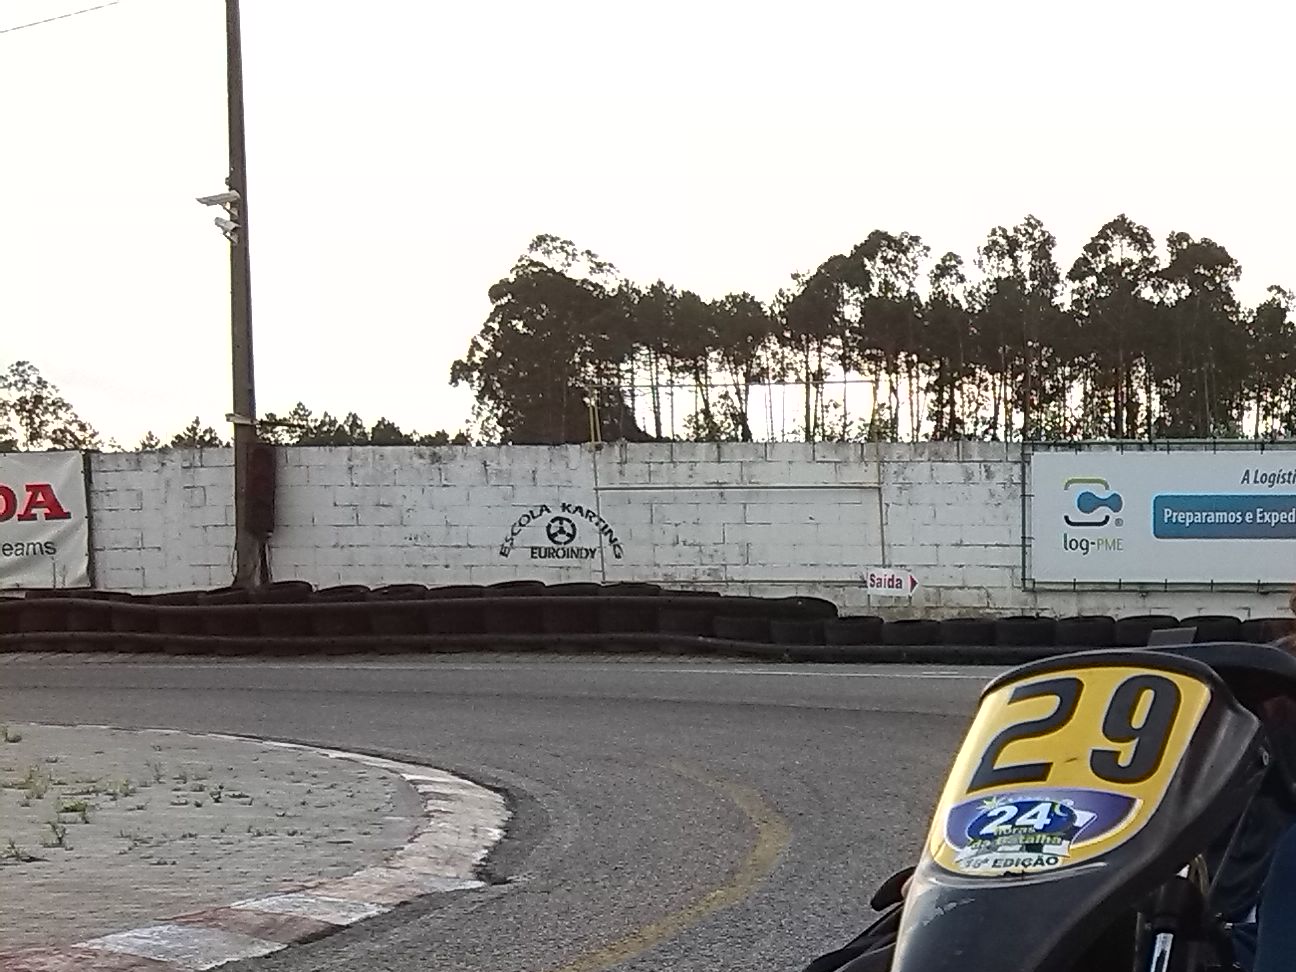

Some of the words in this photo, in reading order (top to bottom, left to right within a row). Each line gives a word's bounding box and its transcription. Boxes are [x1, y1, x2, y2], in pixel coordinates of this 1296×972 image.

[1241, 469, 1250, 484] A
[1163, 508, 1242, 527] Preparamos
[1244, 511, 1253, 523] e
[499, 504, 551, 558] ESCOLA
[561, 502, 624, 559] KARTING
[1, 541, 57, 556] eams
[530, 546, 597, 559] EUROINDY
[1063, 532, 1124, 555] log-PME
[966, 674, 1182, 794] 29
[979, 802, 1052, 835] 24
[992, 855, 1060, 868] EDIÇÃO
